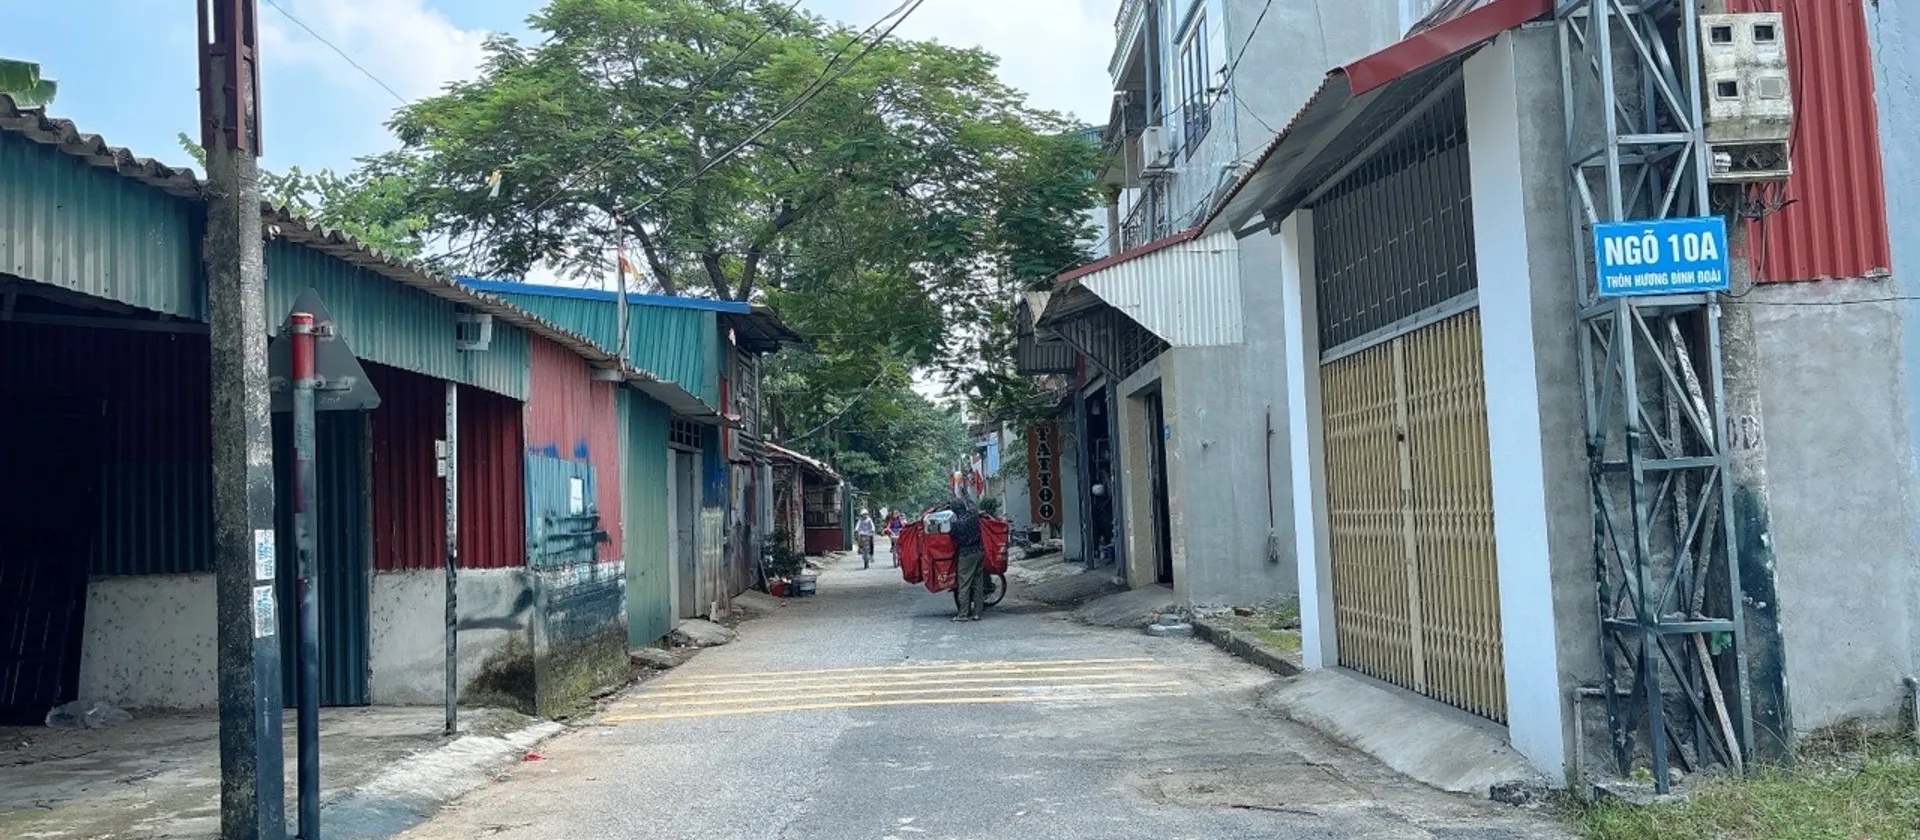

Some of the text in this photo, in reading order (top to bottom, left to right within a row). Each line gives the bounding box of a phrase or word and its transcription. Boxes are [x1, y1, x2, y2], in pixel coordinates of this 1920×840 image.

[1604, 229, 1718, 266] NGÕ 10A
[1606, 272, 1632, 288] THÔN
[1035, 427, 1055, 519] TATTOO
